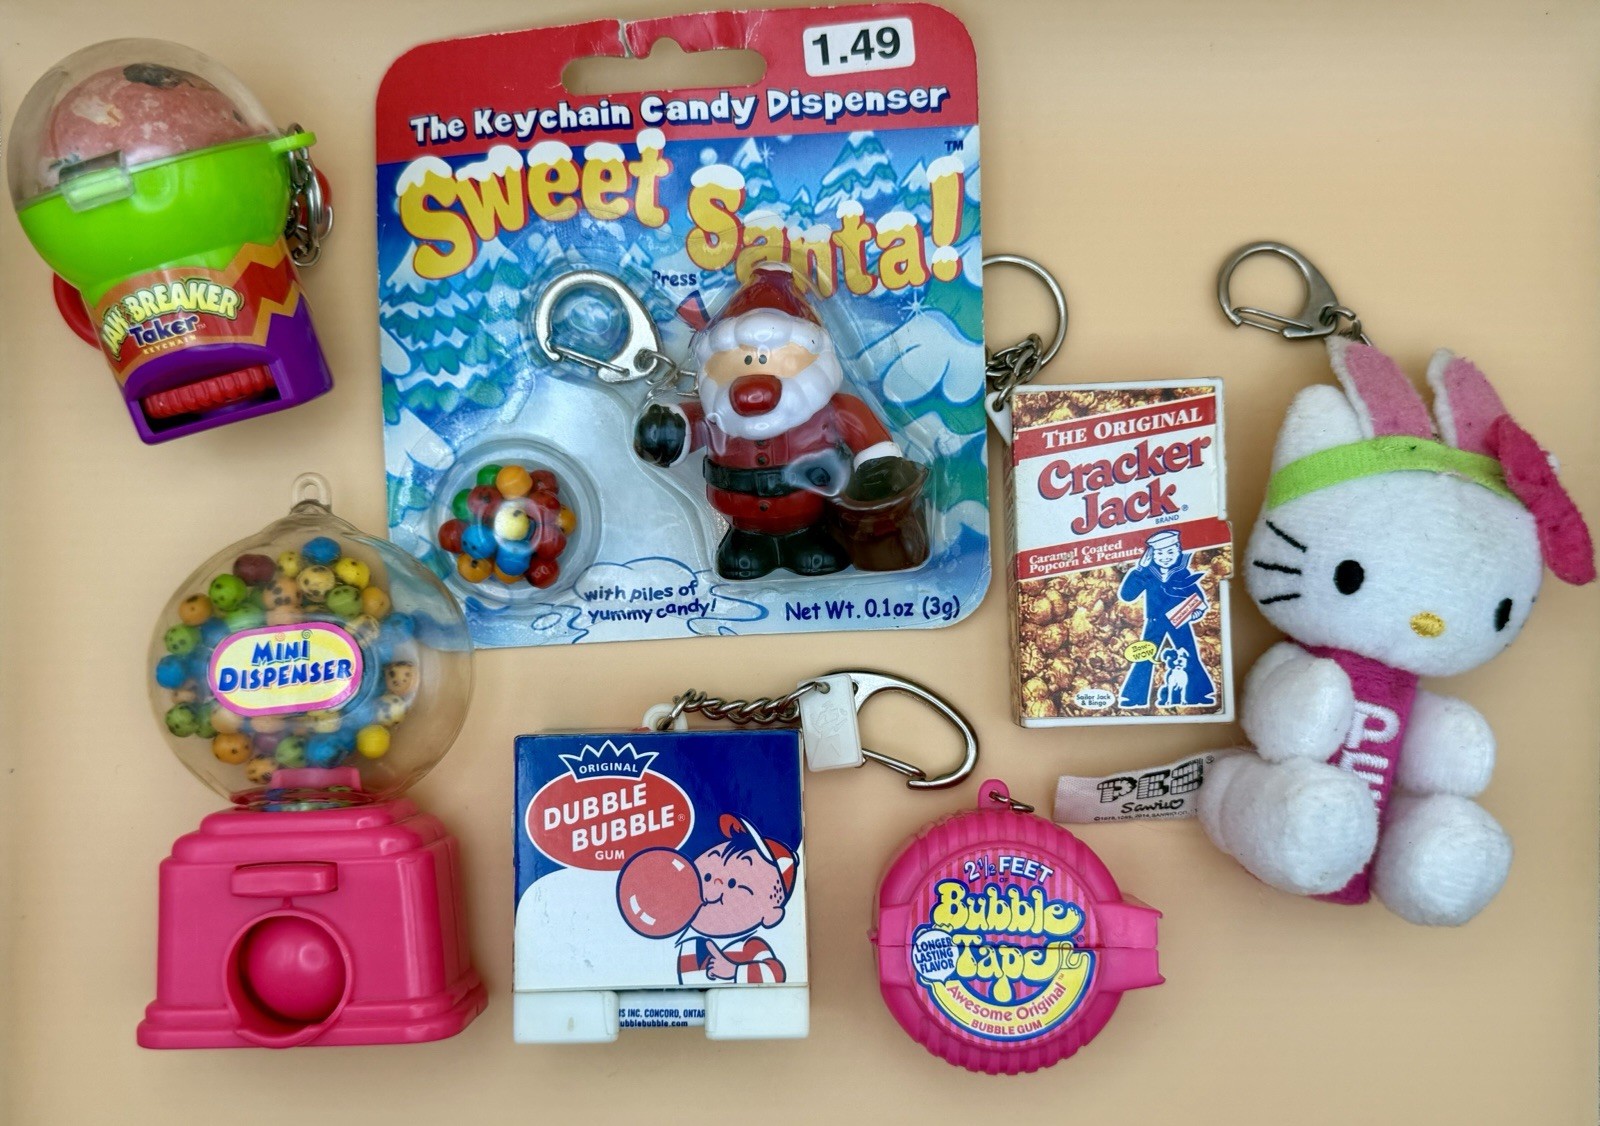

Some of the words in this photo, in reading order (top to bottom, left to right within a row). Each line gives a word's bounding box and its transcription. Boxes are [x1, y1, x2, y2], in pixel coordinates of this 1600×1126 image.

[811, 26, 901, 66] 1.49
[410, 115, 469, 142] The
[474, 101, 633, 138] Keychain
[640, 89, 758, 129] Candy
[766, 84, 950, 120] Dispenser
[397, 128, 671, 280] Sweet
[686, 163, 966, 297] Santa!
[652, 270, 697, 286] Press
[124, 280, 243, 321] BREAKER
[129, 314, 199, 347] Taker
[143, 335, 197, 355] KEYCHAIN
[1042, 428, 1087, 449] THE
[1094, 407, 1203, 440] ORIGINAL
[1038, 436, 1212, 500] Cracker
[1070, 478, 1180, 535] Jack
[1155, 514, 1180, 525] BRAND
[1029, 559, 1080, 573] Popcorn
[1082, 554, 1093, 564] &
[1096, 547, 1145, 561] Peanuts
[1081, 541, 1123, 556] Coated
[584, 586, 627, 602] with
[630, 584, 674, 604] piles
[678, 581, 700, 597] of
[588, 606, 652, 625] yummy
[656, 598, 718, 618] candy!
[785, 601, 823, 621] Net
[826, 600, 861, 620] Wt.
[865, 600, 915, 620] 0.1oz
[923, 596, 962, 621] (3g)
[218, 659, 354, 691] DISPENSER
[1076, 693, 1095, 701] Sailor
[579, 762, 639, 774] ORIGINAL
[543, 783, 647, 831] DUBBLE
[1121, 799, 1184, 814] Sanrio
[571, 804, 675, 852] BUBBLE
[595, 850, 625, 860] GUM
[998, 856, 1055, 884] FEET
[933, 881, 1082, 936] Bubble
[915, 948, 954, 964] LASTING
[916, 937, 953, 953] LONGER
[920, 958, 955, 974] FLAVOR
[952, 934, 1066, 1003] Tape
[627, 1008, 642, 1018] INC.
[644, 1008, 682, 1019] CONCORD,
[946, 984, 1013, 1022] Awesome
[1016, 983, 1067, 1019] Original
[970, 1019, 1015, 1035] BUBBLE
[1017, 1020, 1043, 1034] GUM
